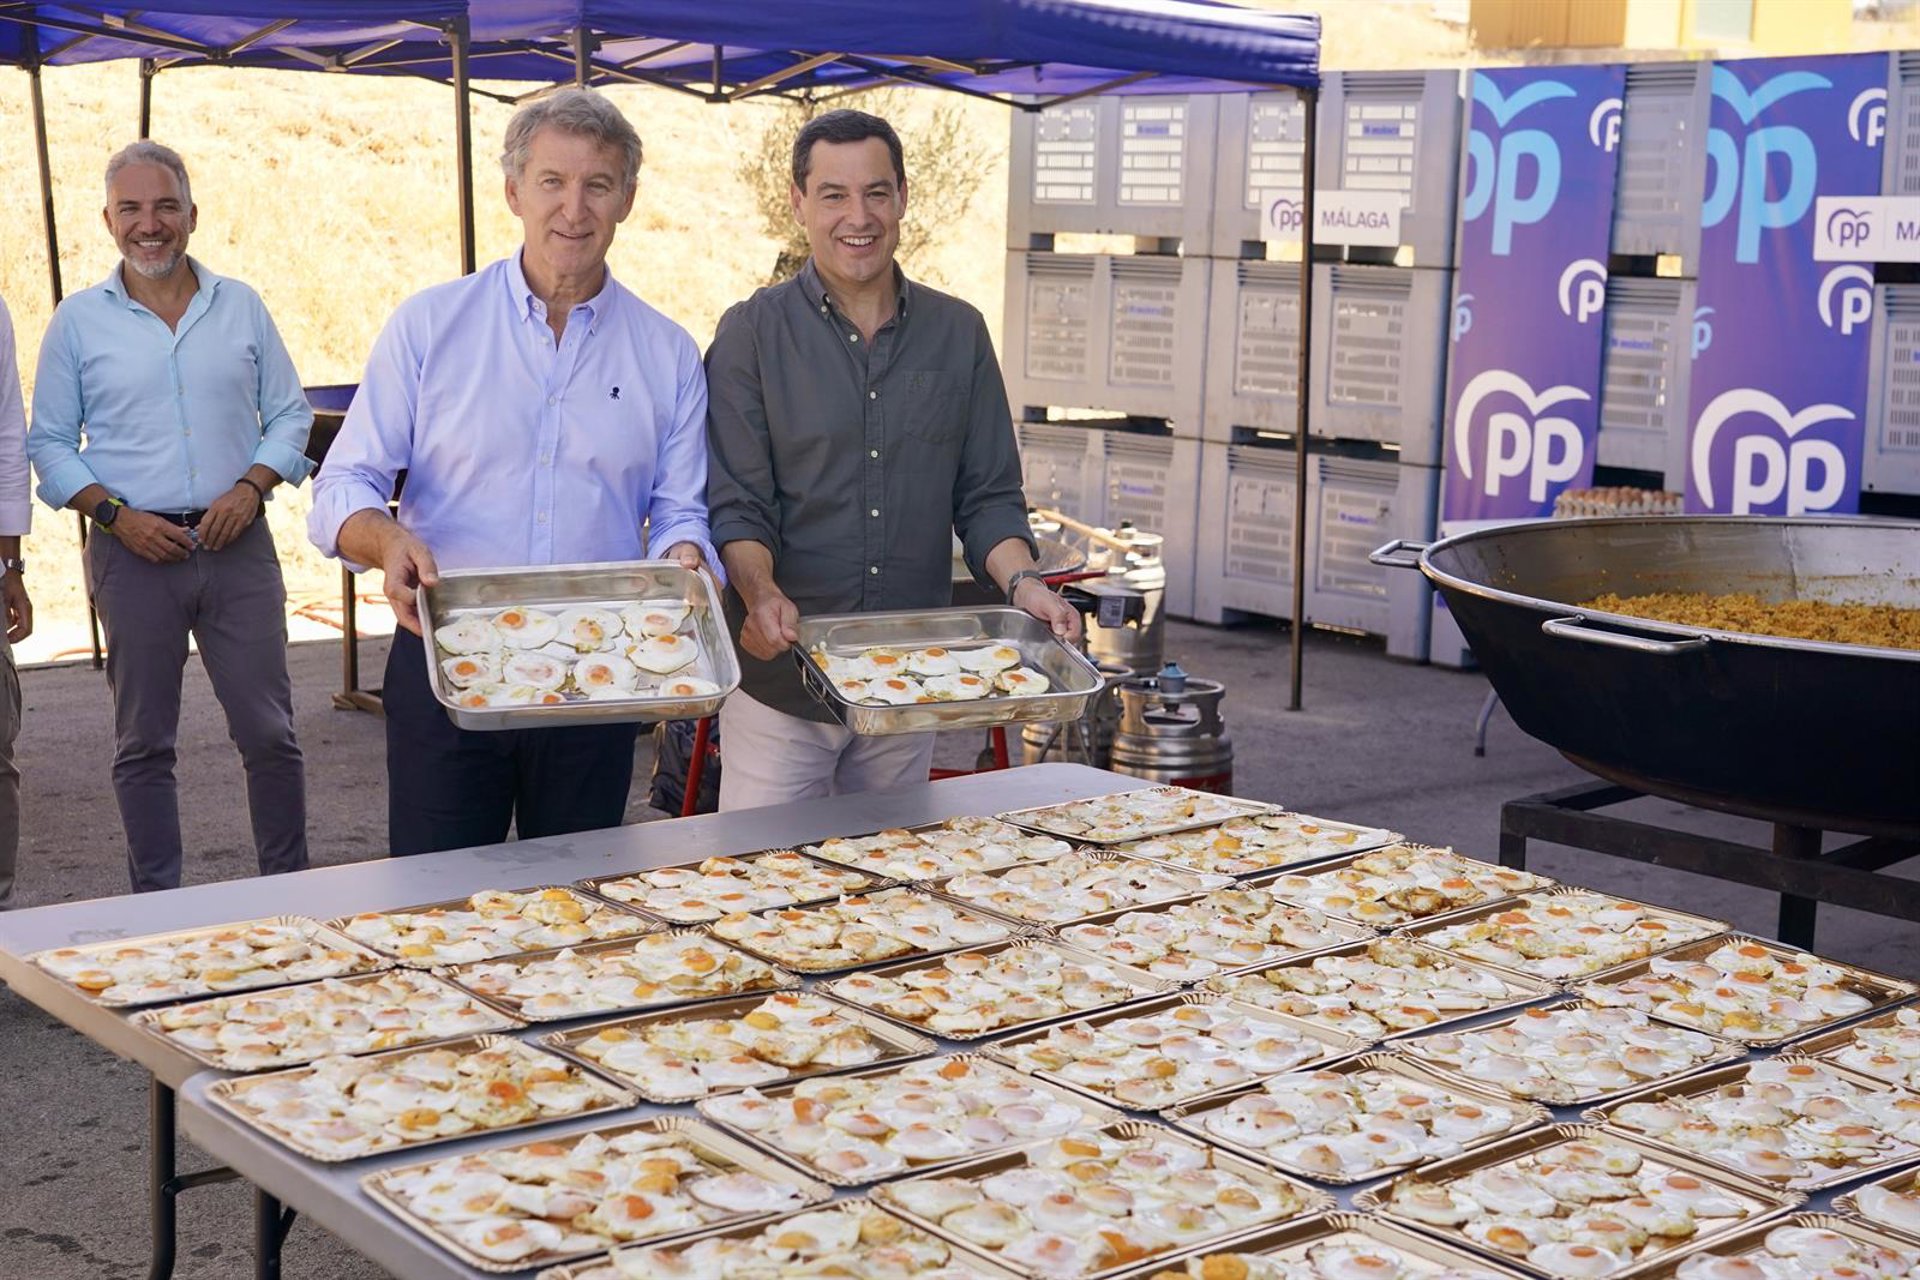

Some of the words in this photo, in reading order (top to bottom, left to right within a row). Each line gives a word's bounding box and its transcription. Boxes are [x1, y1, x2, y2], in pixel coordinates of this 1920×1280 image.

[1280, 210, 1303, 231] pp
[1321, 206, 1390, 228] MÁLAGA
[1840, 221, 1870, 247] pp
[1485, 412, 1584, 503] pp
[1732, 434, 1846, 516] pp
